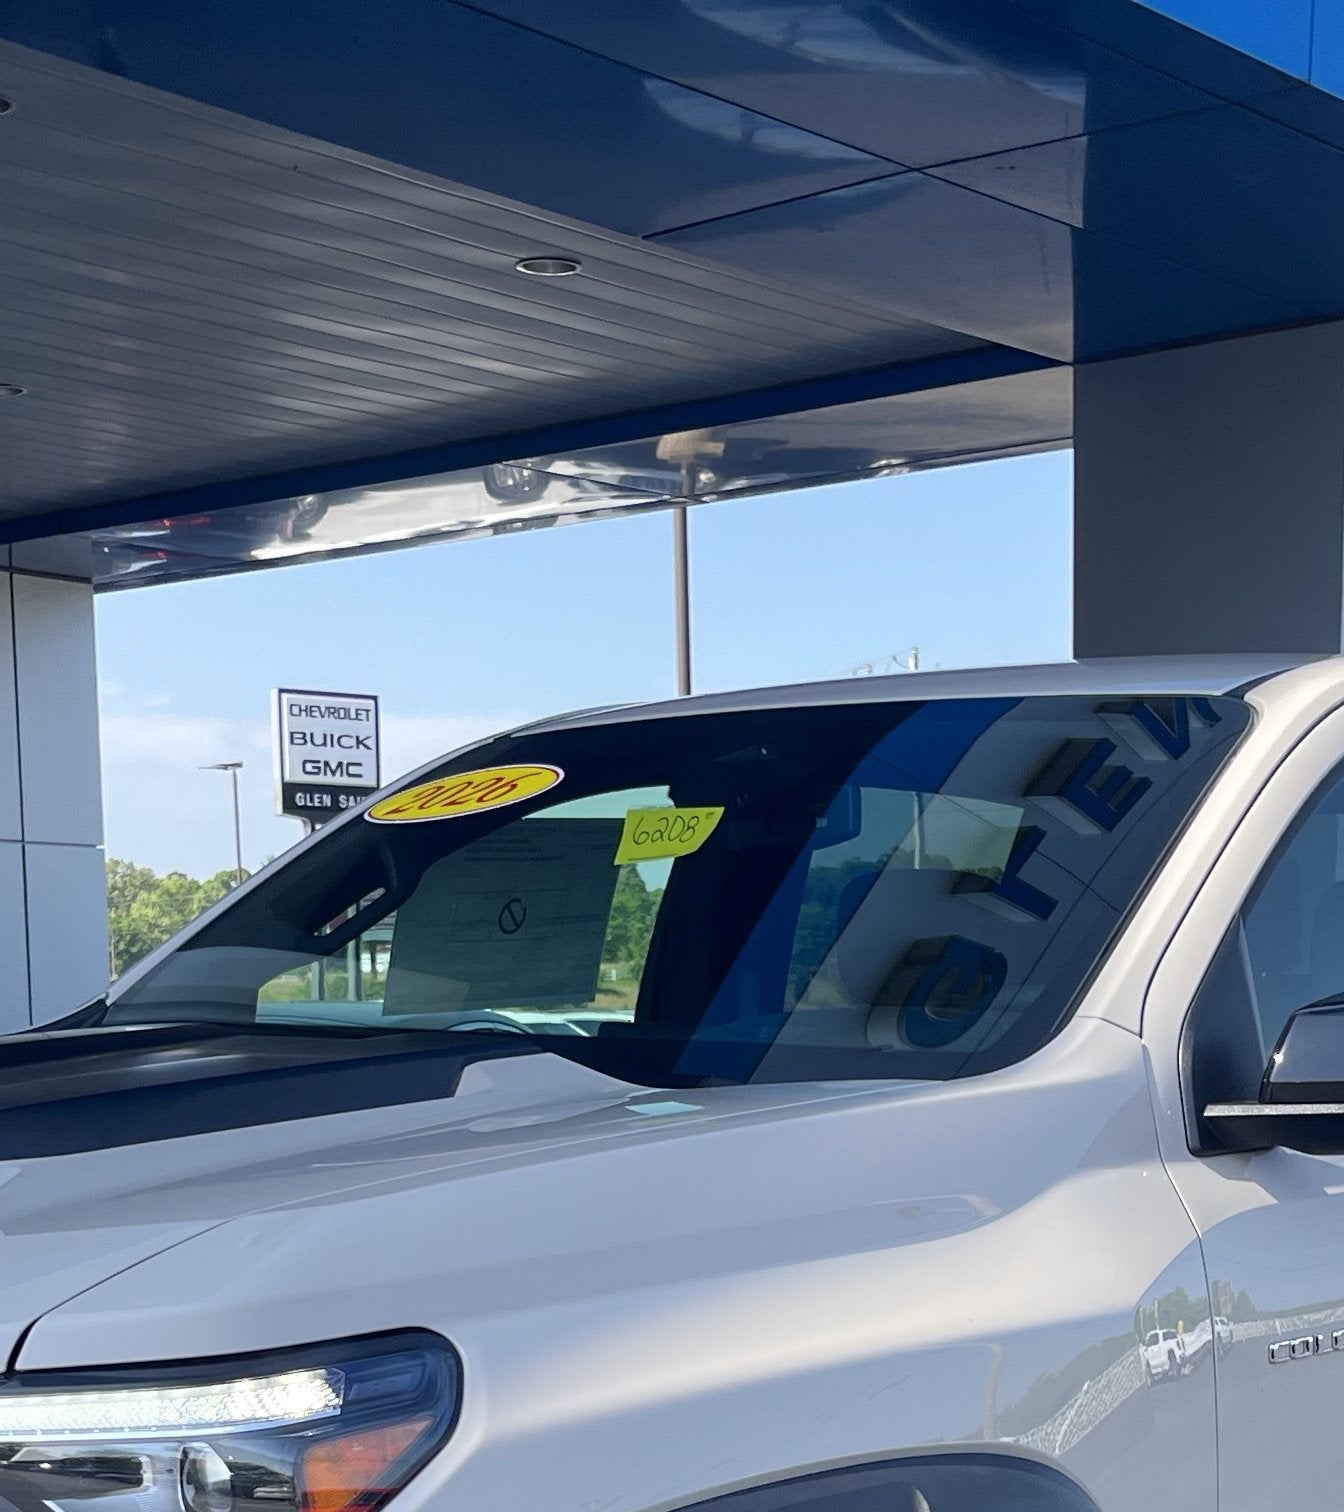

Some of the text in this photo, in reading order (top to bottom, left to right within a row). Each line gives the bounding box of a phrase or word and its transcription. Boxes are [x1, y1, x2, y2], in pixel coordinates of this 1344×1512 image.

[289, 703, 372, 722] CHEVROLET
[289, 731, 373, 750] BUICK
[302, 759, 364, 778] GMC
[294, 792, 332, 808] GLEN
[386, 771, 544, 816] 2026
[631, 815, 699, 846] 6208
